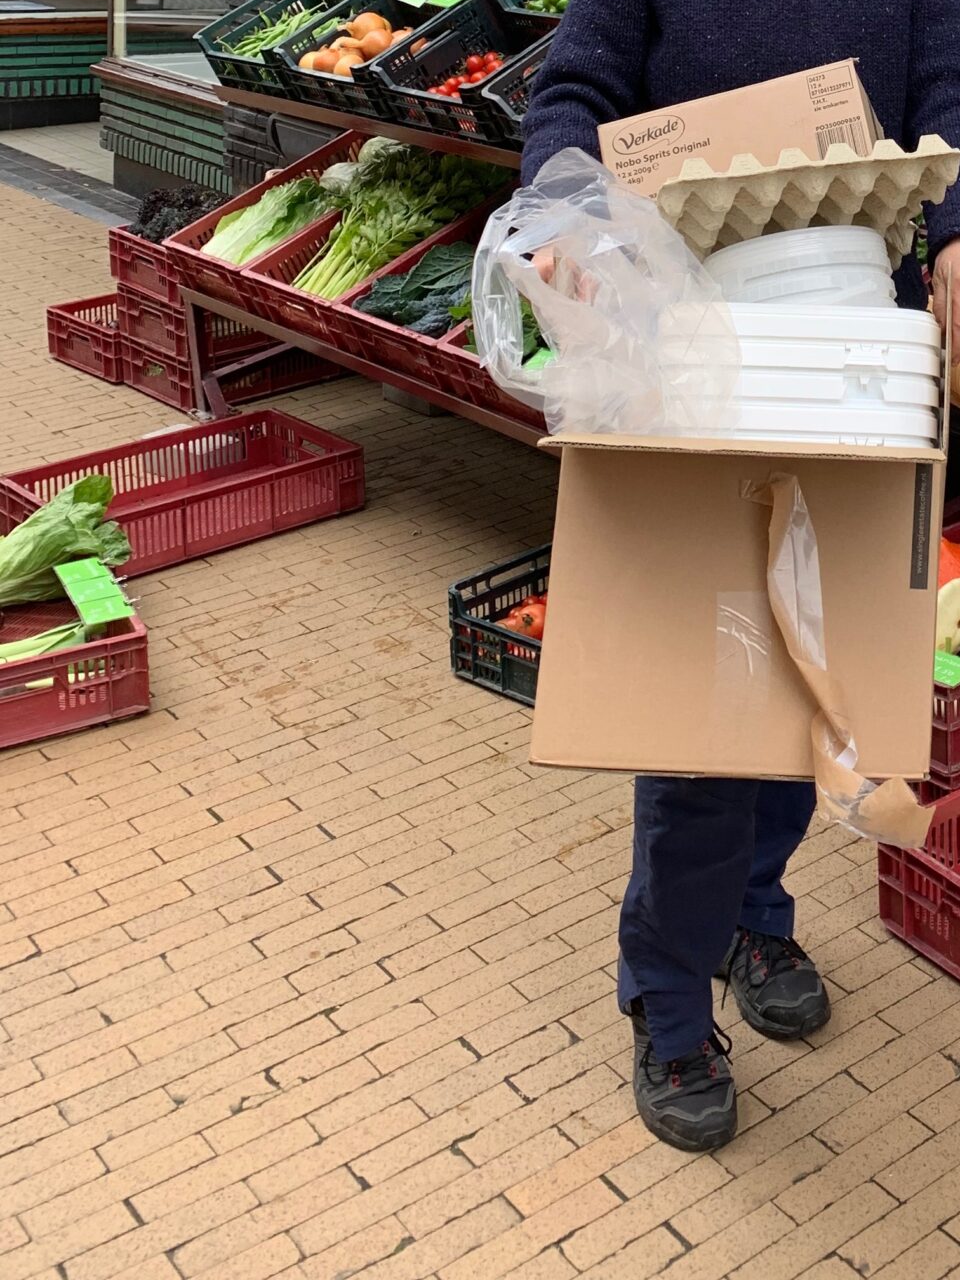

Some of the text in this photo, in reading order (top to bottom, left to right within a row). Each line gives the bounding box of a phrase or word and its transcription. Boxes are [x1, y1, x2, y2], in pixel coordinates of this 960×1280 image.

[618, 119, 679, 150] Verkade
[615, 138, 711, 170] Nobo Sprits Original
